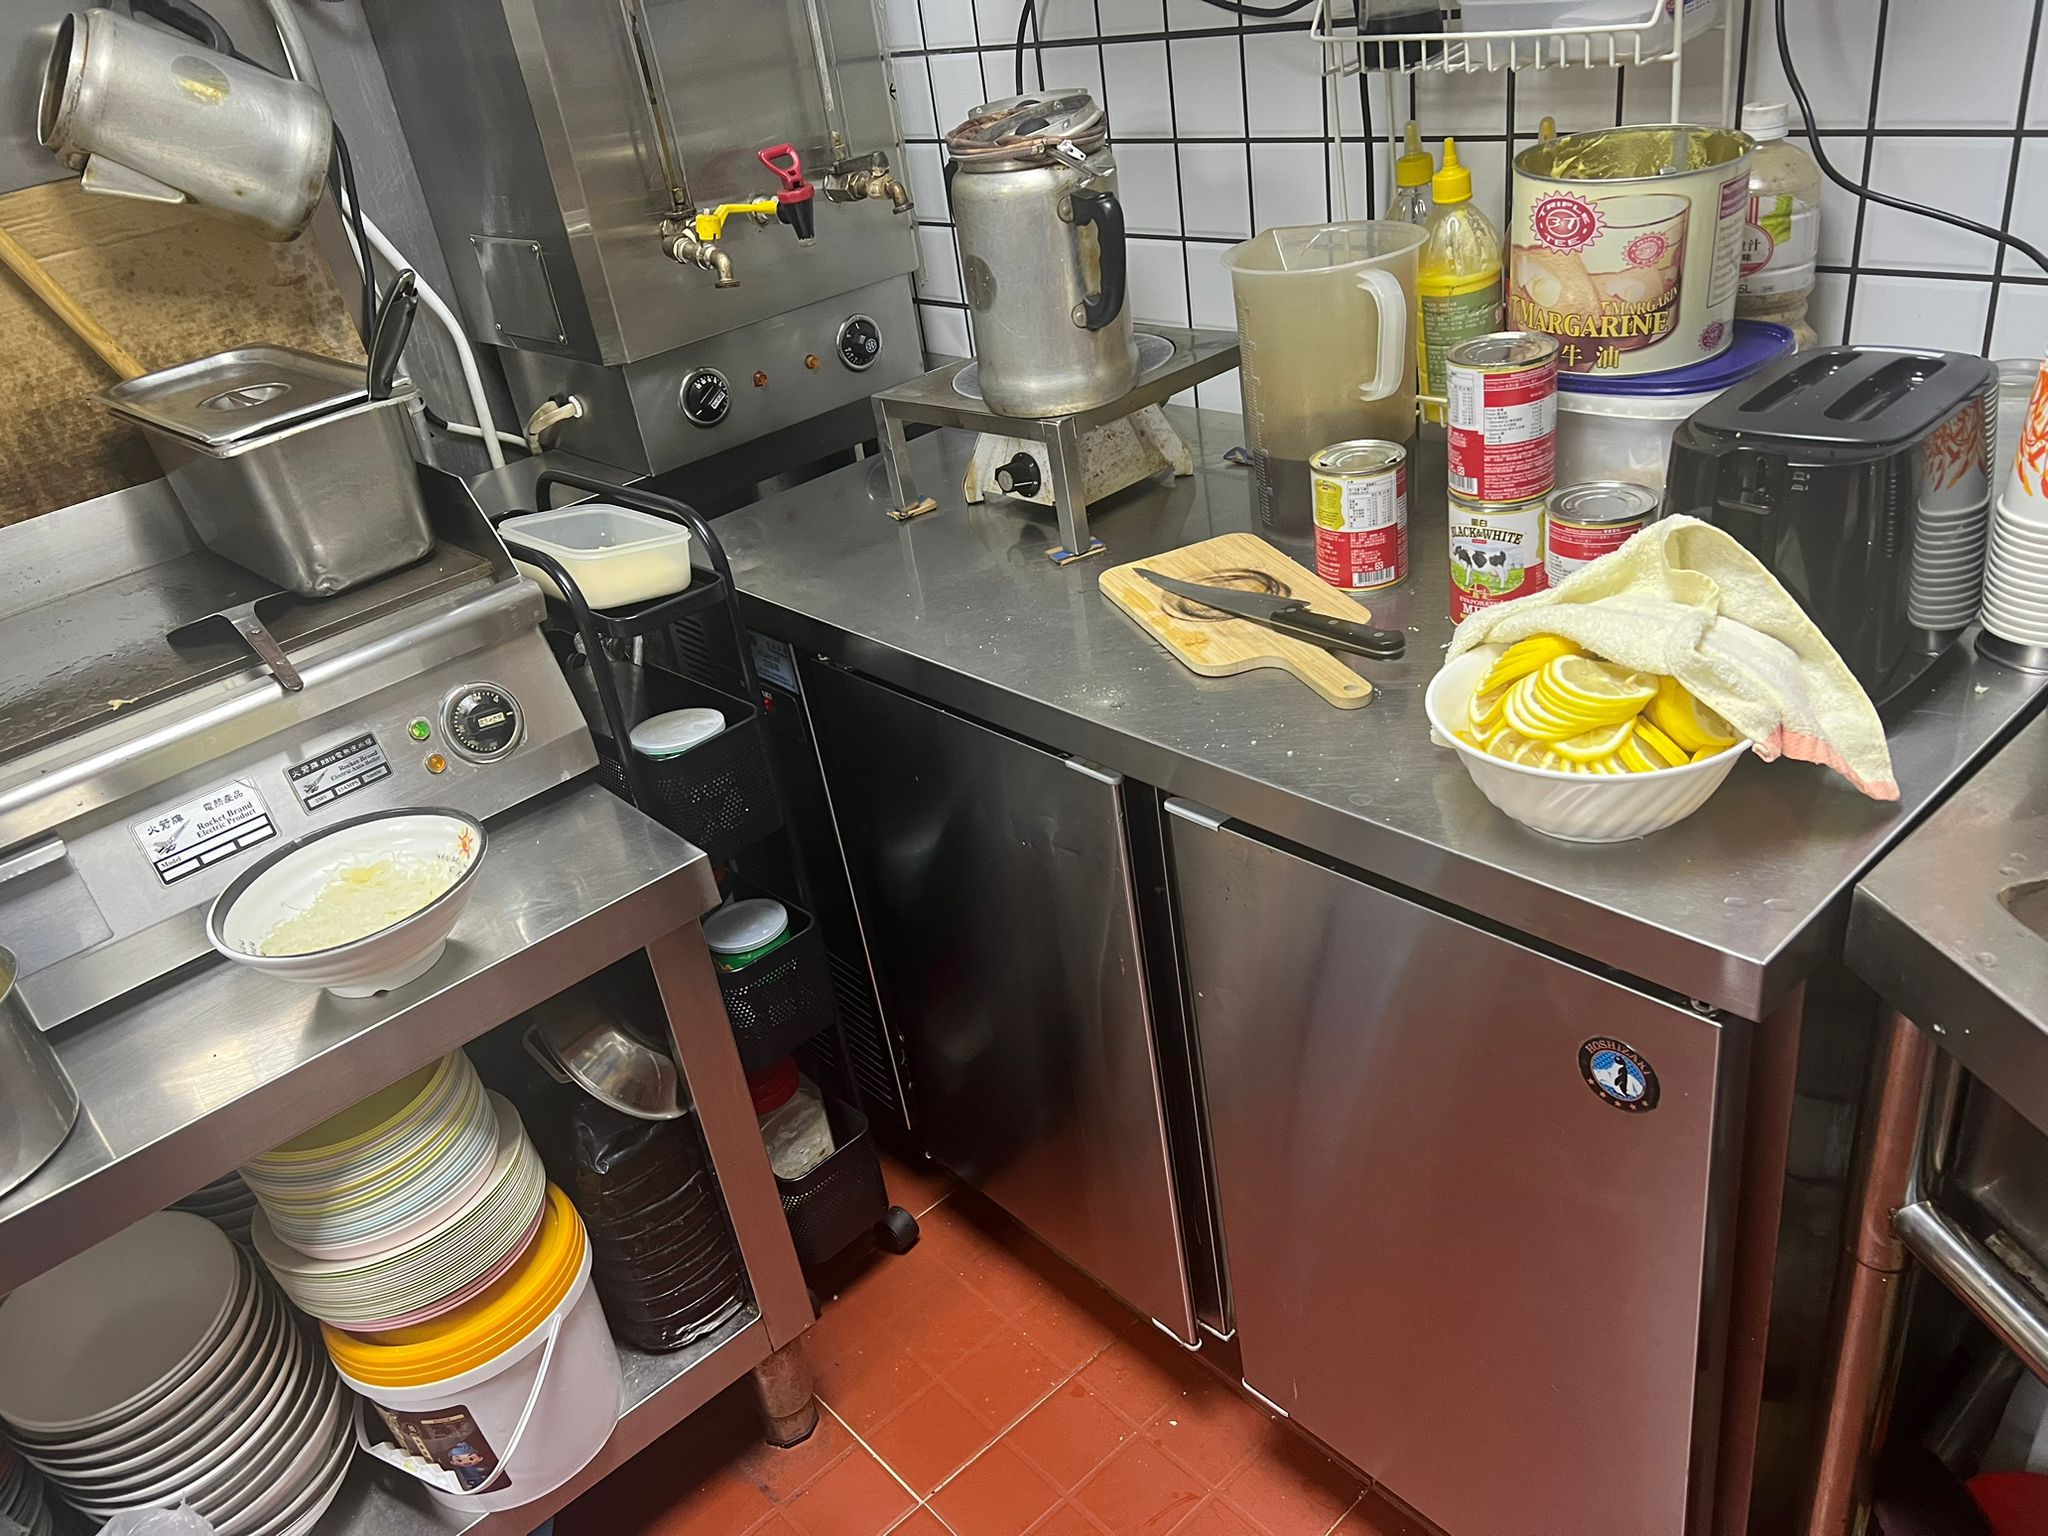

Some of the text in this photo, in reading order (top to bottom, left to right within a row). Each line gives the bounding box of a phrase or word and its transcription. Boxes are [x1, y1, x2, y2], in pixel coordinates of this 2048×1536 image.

[1538, 201, 1590, 225] TRIPLE
[1544, 232, 1581, 247] TEE
[1609, 283, 1680, 316] MARGARIN
[1519, 298, 1670, 338] MARGARINE
[196, 801, 253, 830] Rocket Brand
[197, 808, 257, 838] Electric Product
[160, 856, 182, 869] Model
[1585, 1040, 1651, 1075] HOSHIZAKI
